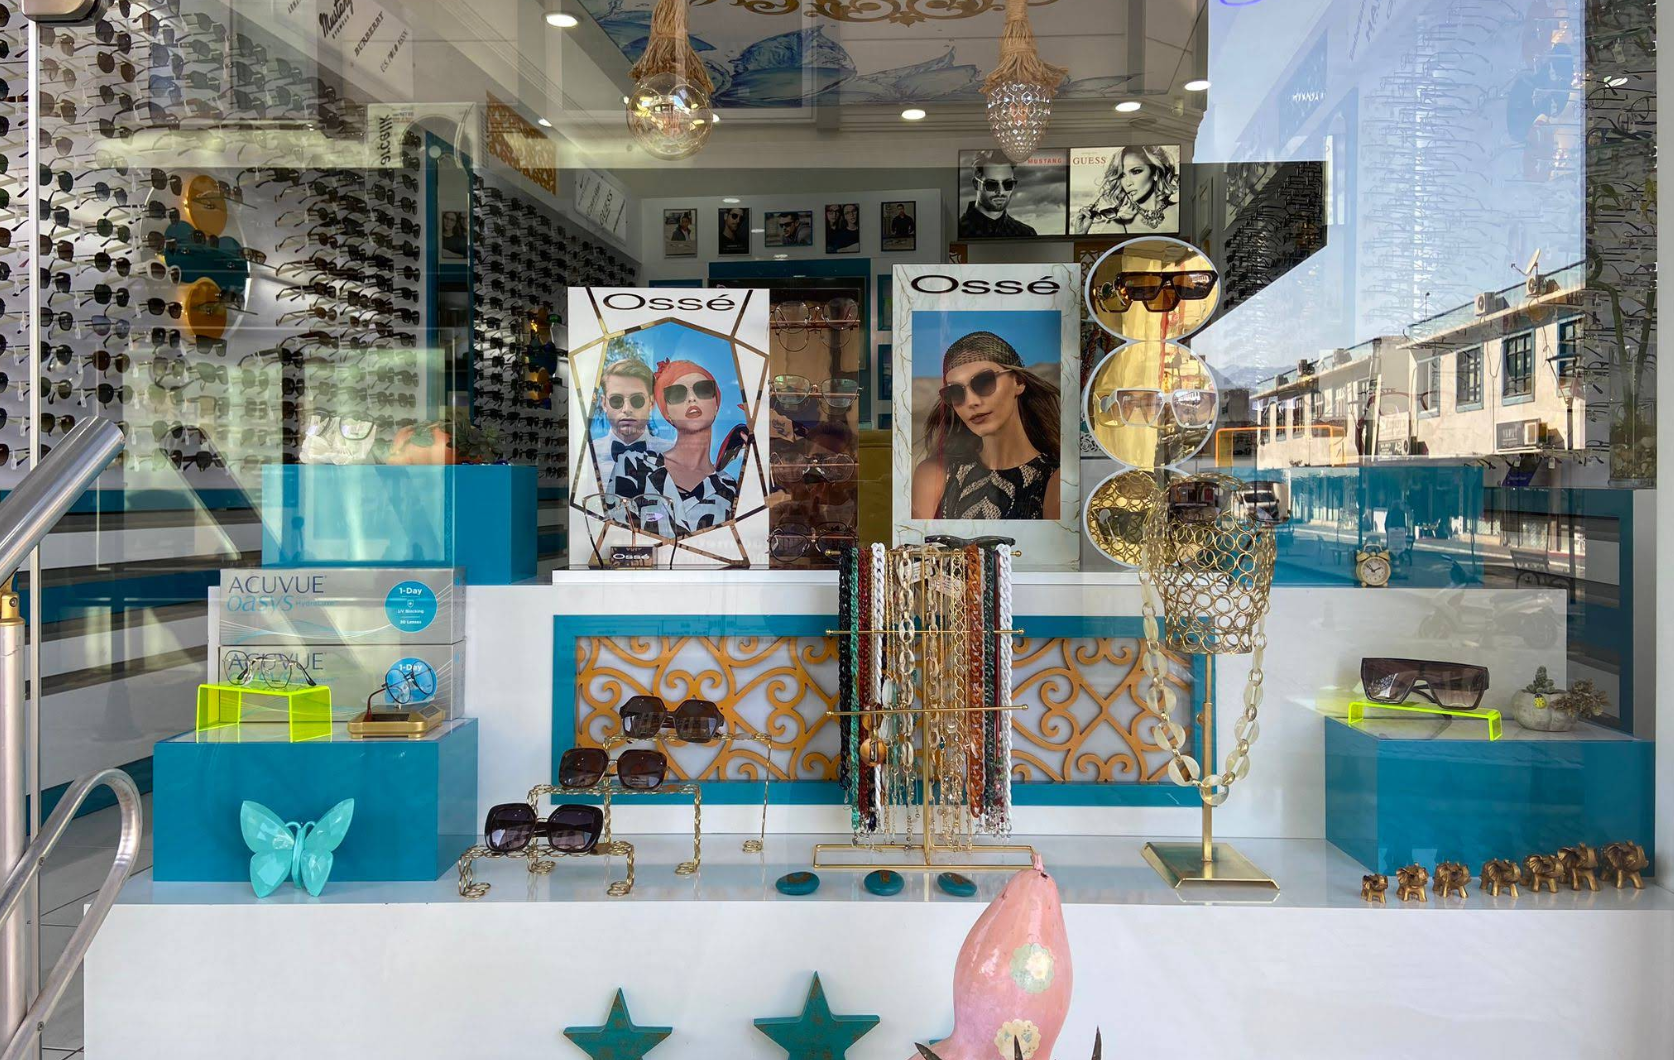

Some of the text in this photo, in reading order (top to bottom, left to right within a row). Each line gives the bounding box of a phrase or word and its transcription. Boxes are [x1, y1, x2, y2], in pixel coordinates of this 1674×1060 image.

[354, 11, 385, 57] BURBERRY
[1027, 157, 1062, 165] MUSTANG
[1072, 156, 1107, 165] GUESS
[910, 274, 1061, 295] Ossé
[602, 293, 736, 311] Ossé
[398, 587, 423, 596] 1-Day
